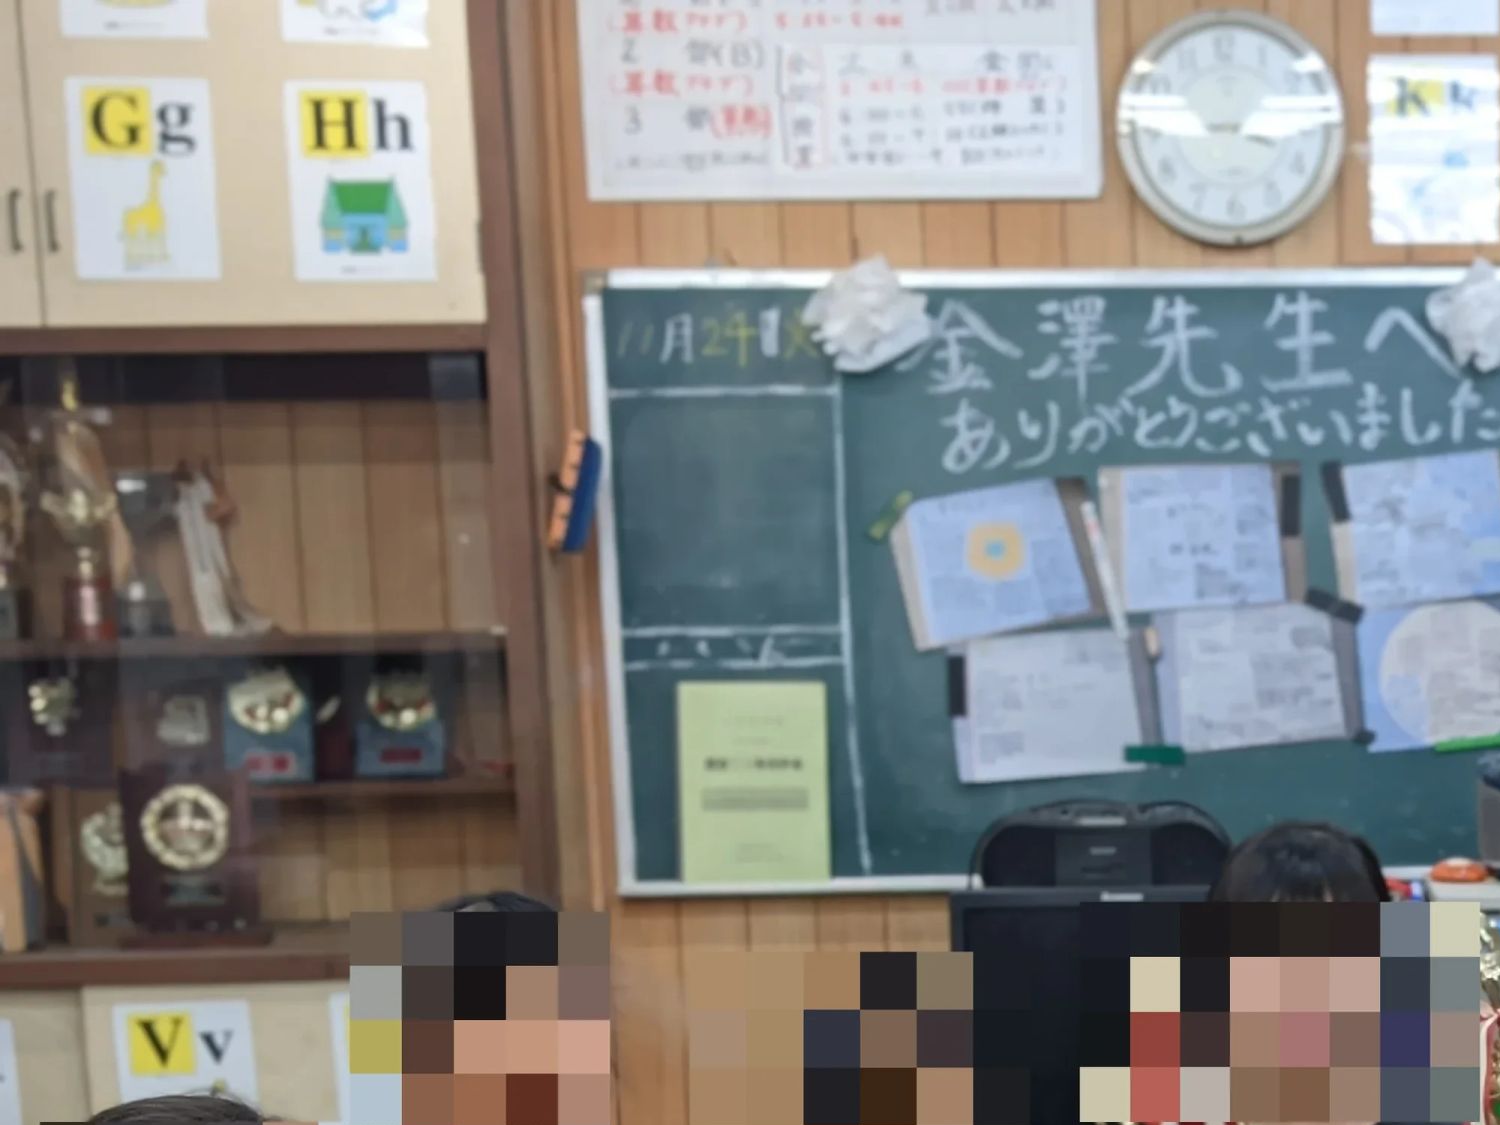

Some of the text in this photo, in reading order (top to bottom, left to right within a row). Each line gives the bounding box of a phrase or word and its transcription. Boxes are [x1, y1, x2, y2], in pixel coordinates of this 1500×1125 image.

[1213, 32, 1236, 63] 12
[90, 91, 197, 157] Gg
[308, 96, 414, 152] Hh
[136, 1018, 234, 1068] Vv
